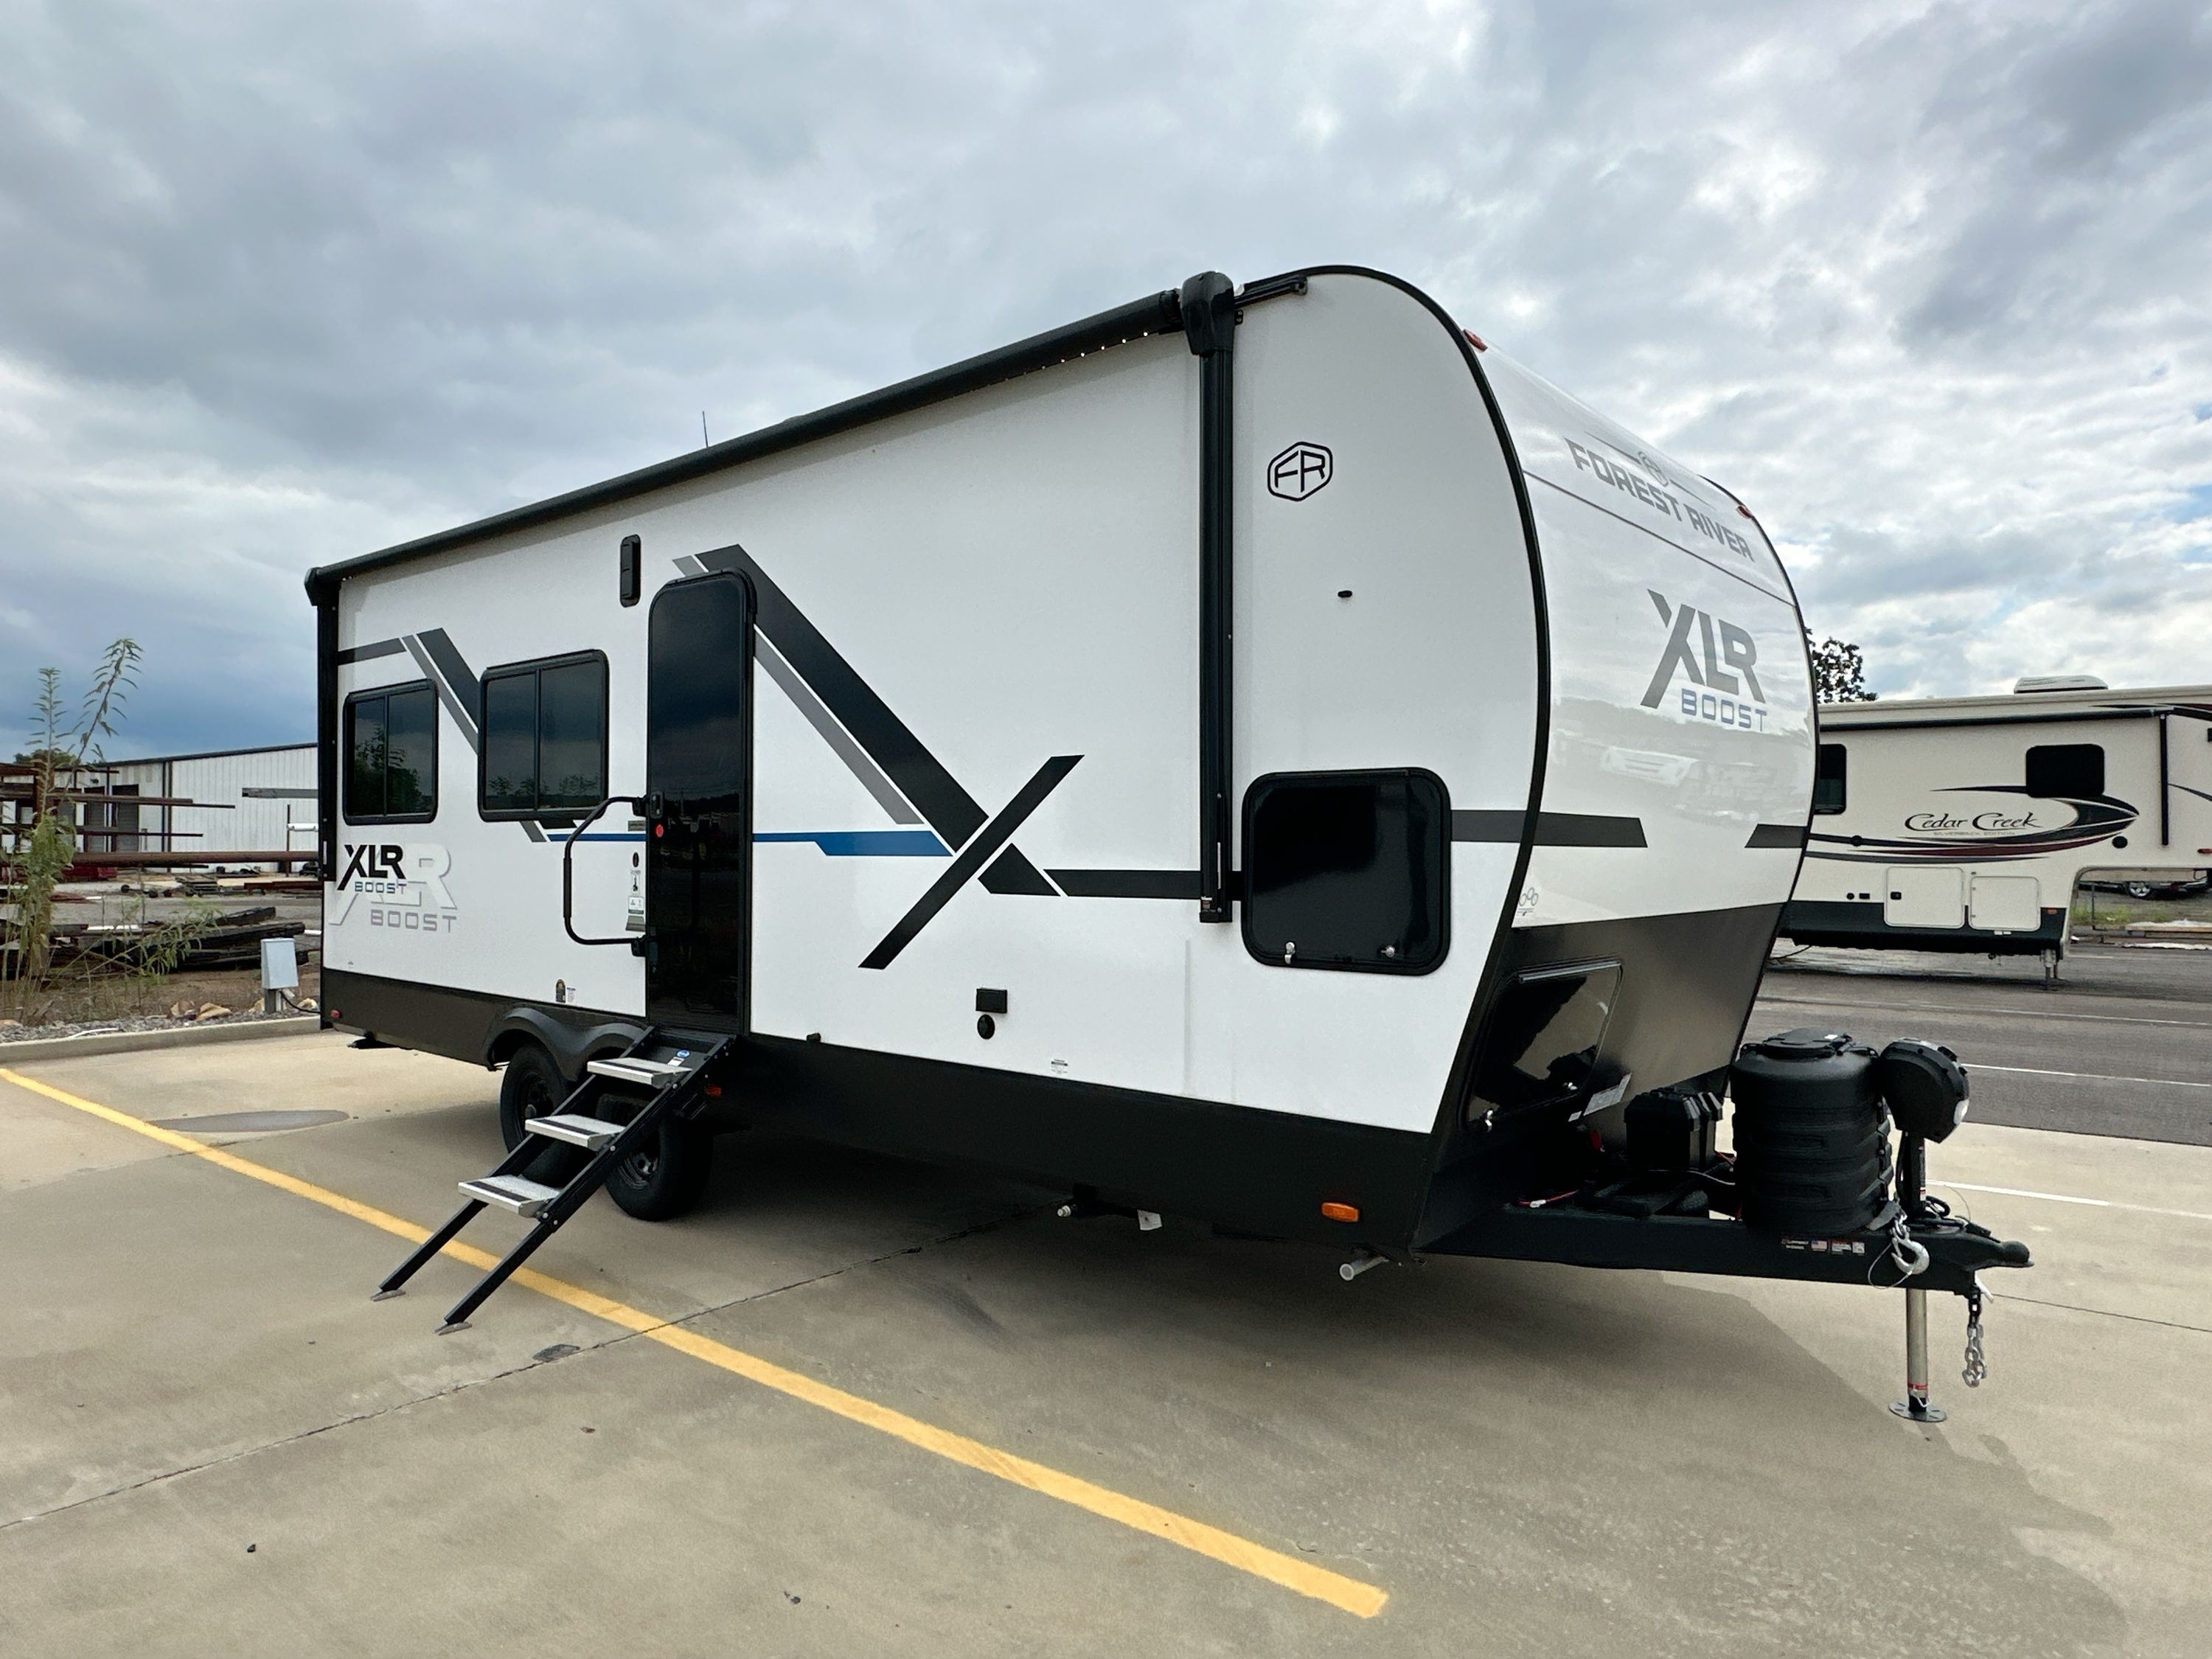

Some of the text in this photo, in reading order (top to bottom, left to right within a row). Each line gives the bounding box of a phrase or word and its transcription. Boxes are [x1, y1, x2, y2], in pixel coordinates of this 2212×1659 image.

[1563, 437, 1756, 563] FOREST RIVER
[1640, 588, 1766, 709] XLR
[1681, 688, 1767, 731] BOOST
[1905, 812, 2043, 831] Cedar Creek
[337, 844, 406, 891] XLR
[355, 881, 407, 894] BOOST
[370, 909, 457, 933] BOOST
